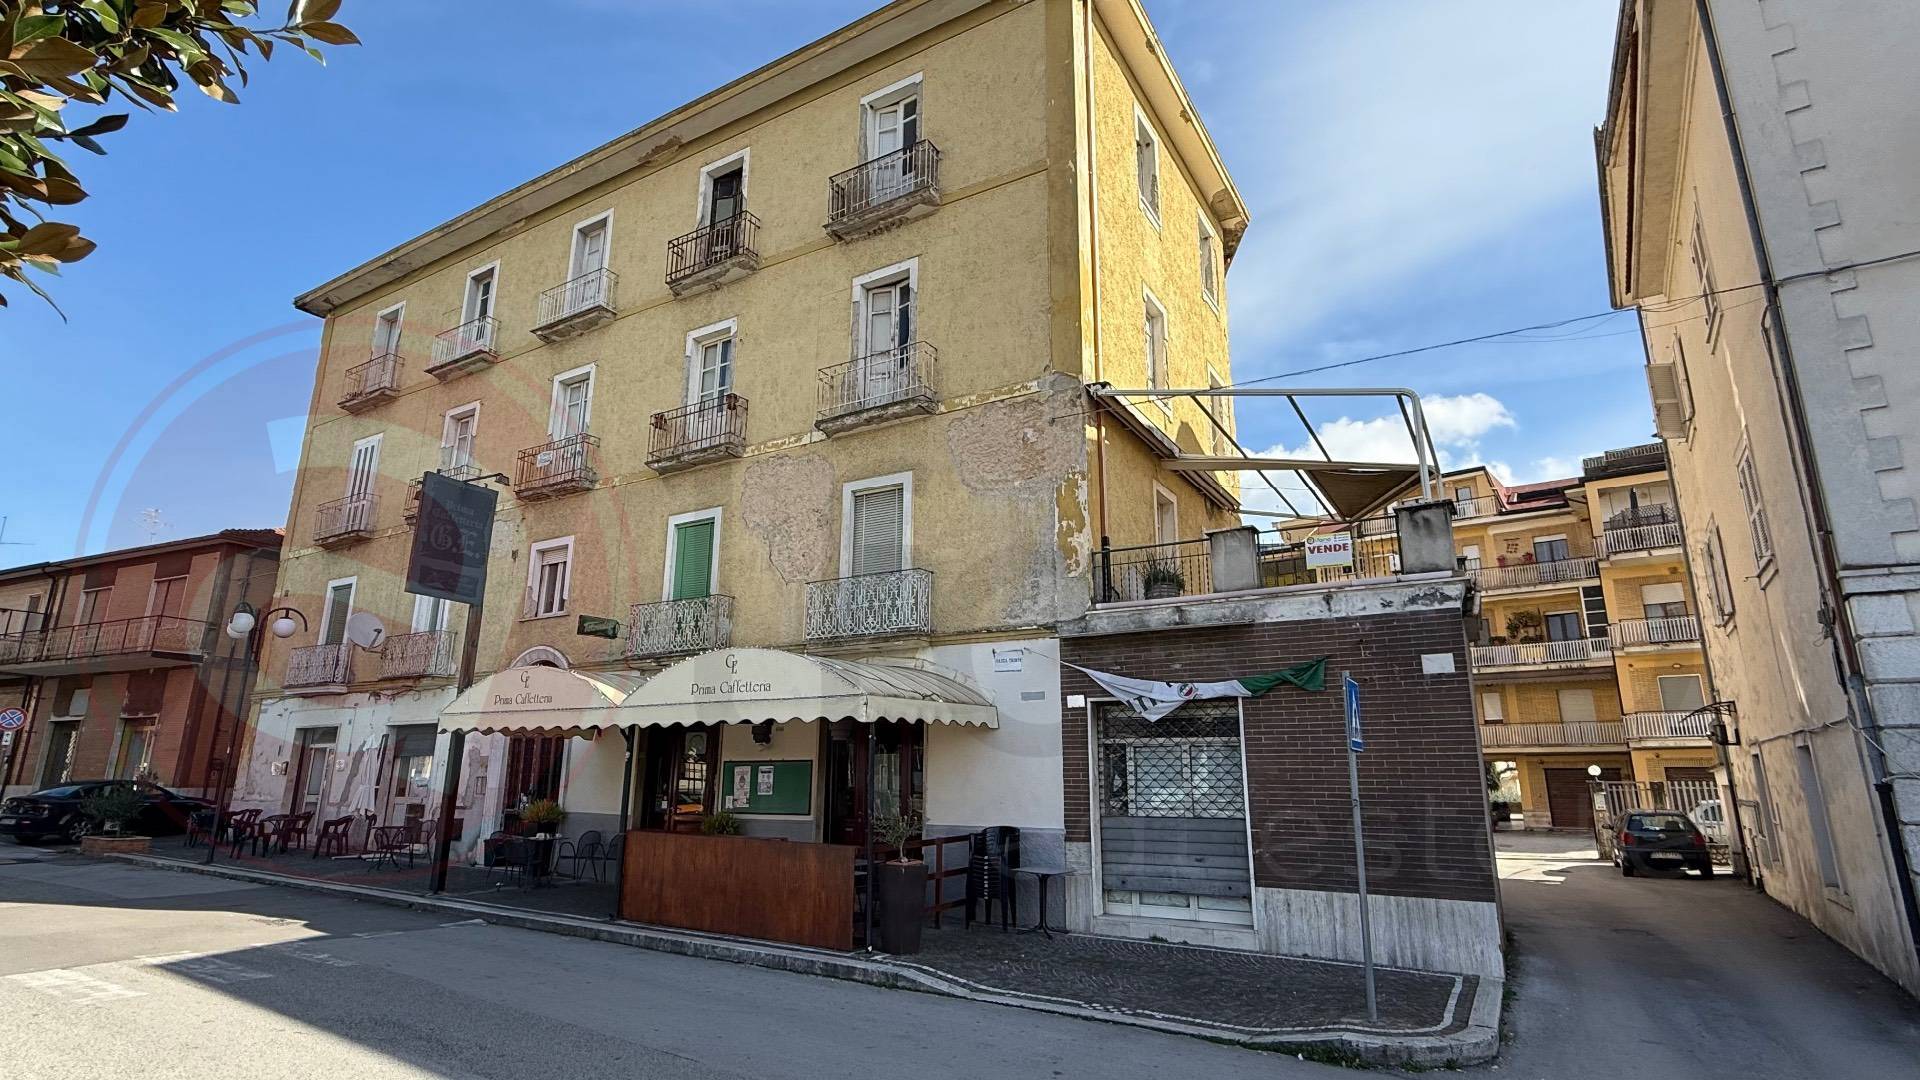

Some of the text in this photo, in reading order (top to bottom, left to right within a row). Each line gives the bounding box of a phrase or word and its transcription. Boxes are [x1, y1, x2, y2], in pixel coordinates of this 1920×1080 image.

[1307, 543, 1349, 554] VENDE
[690, 680, 771, 696] Prima Caffetteria
[493, 692, 553, 706] Prima Caffetteria
